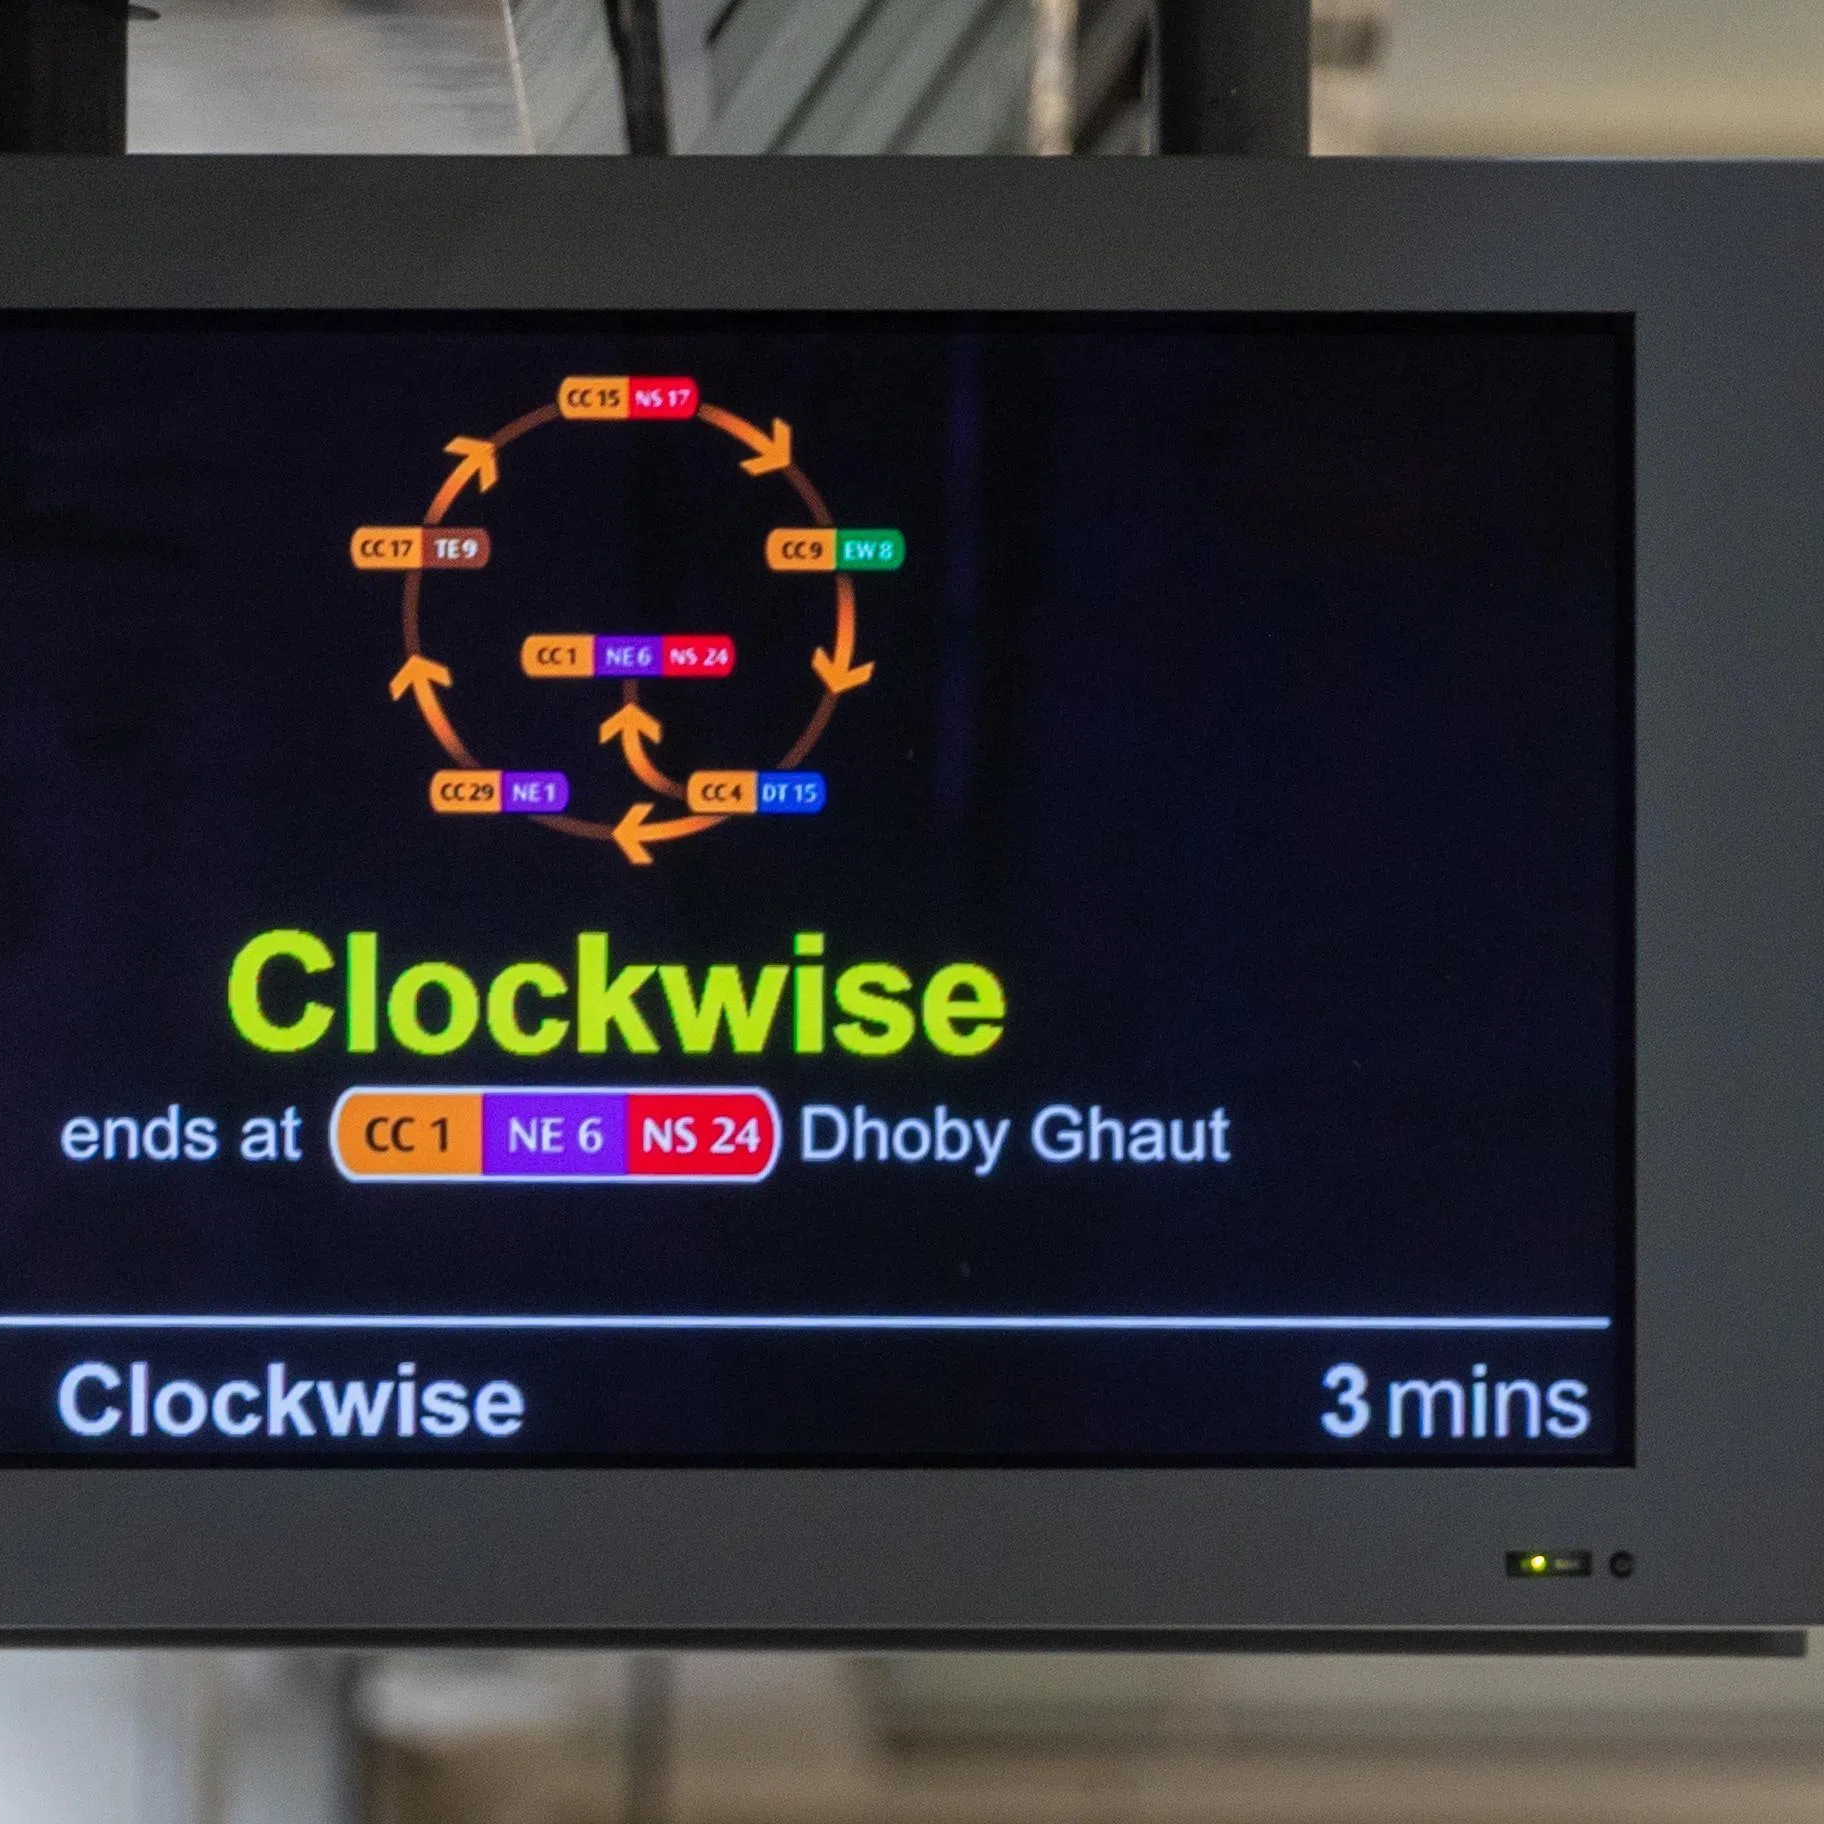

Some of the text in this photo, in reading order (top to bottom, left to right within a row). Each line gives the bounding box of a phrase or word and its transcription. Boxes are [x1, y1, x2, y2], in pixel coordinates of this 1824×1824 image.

[567, 388, 691, 408] CC 15 NS 17
[360, 538, 479, 559] CC 17 TE 9
[781, 540, 895, 560] CC 9 EW 8
[537, 647, 729, 666] CC 1 NE 6 NS 24
[440, 782, 556, 802] CC 29 NE 1
[701, 783, 818, 802] CC 4 DT 15
[227, 928, 1006, 1057] Clockwise
[60, 1103, 1232, 1176] ends at CC 1 NE 6 NS 24 Dhoby Ghaut
[56, 1359, 1590, 1438] Clockwise 3 mins
